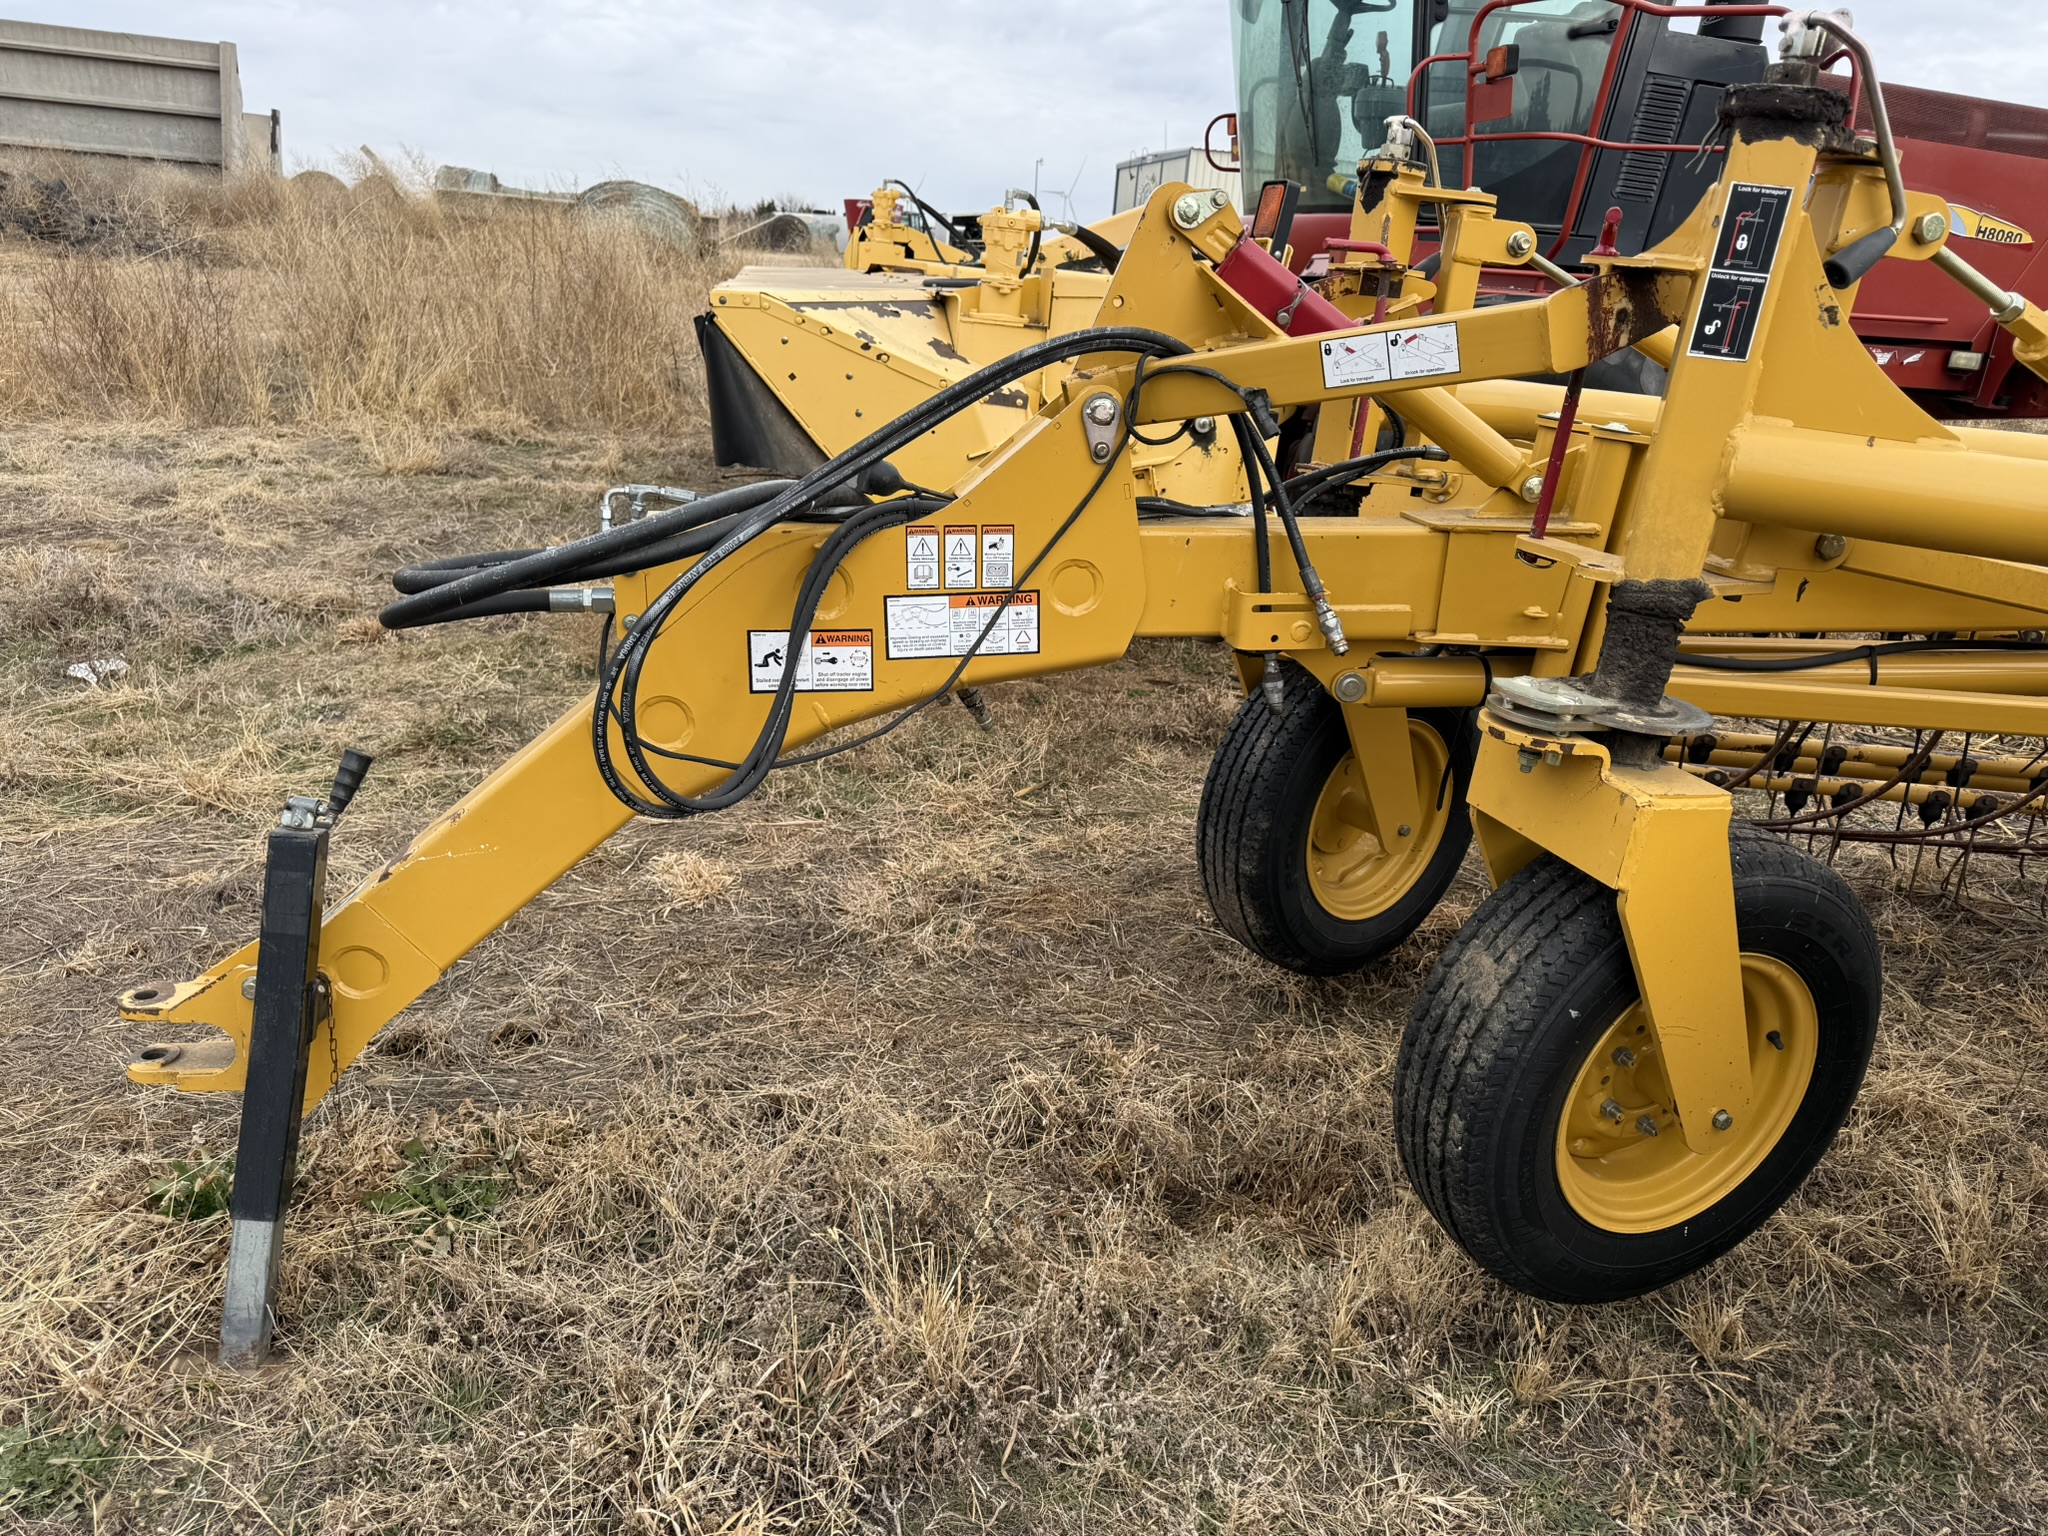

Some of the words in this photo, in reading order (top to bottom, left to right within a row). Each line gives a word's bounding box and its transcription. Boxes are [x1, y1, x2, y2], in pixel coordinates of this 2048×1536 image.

[1976, 225, 2022, 242] H8080
[666, 564, 701, 600] AVENGER
[977, 594, 1032, 605] WARING
[616, 630, 640, 660] T3006A
[598, 690, 609, 709] DN10
[602, 765, 610, 779] 3100
[631, 755, 643, 772] DN10
[640, 771, 652, 785] MAX
